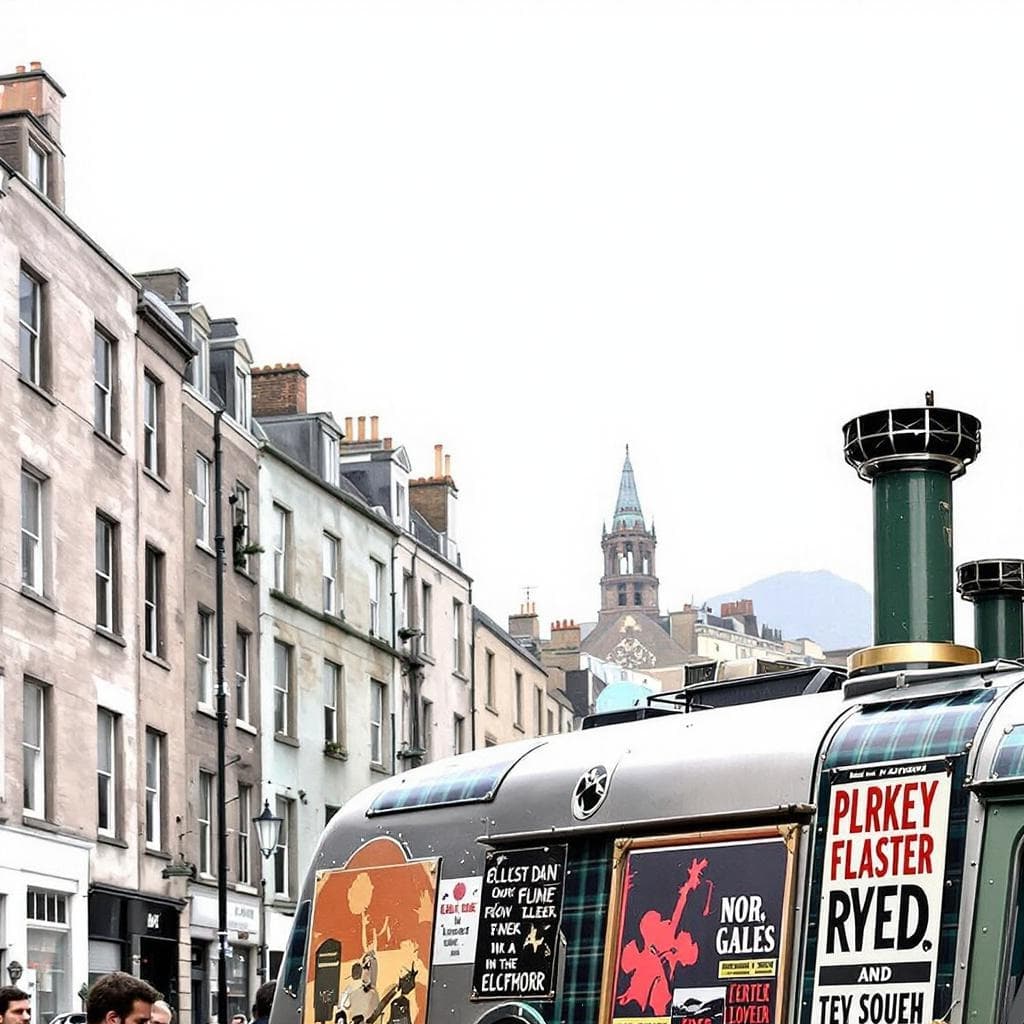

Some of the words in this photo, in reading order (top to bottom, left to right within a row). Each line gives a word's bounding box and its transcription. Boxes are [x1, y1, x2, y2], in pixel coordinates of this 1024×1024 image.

[832, 780, 940, 836] PLRKEY
[830, 833, 935, 881] FLASTER
[715, 924, 776, 955] GALES
[857, 965, 893, 983] AND
